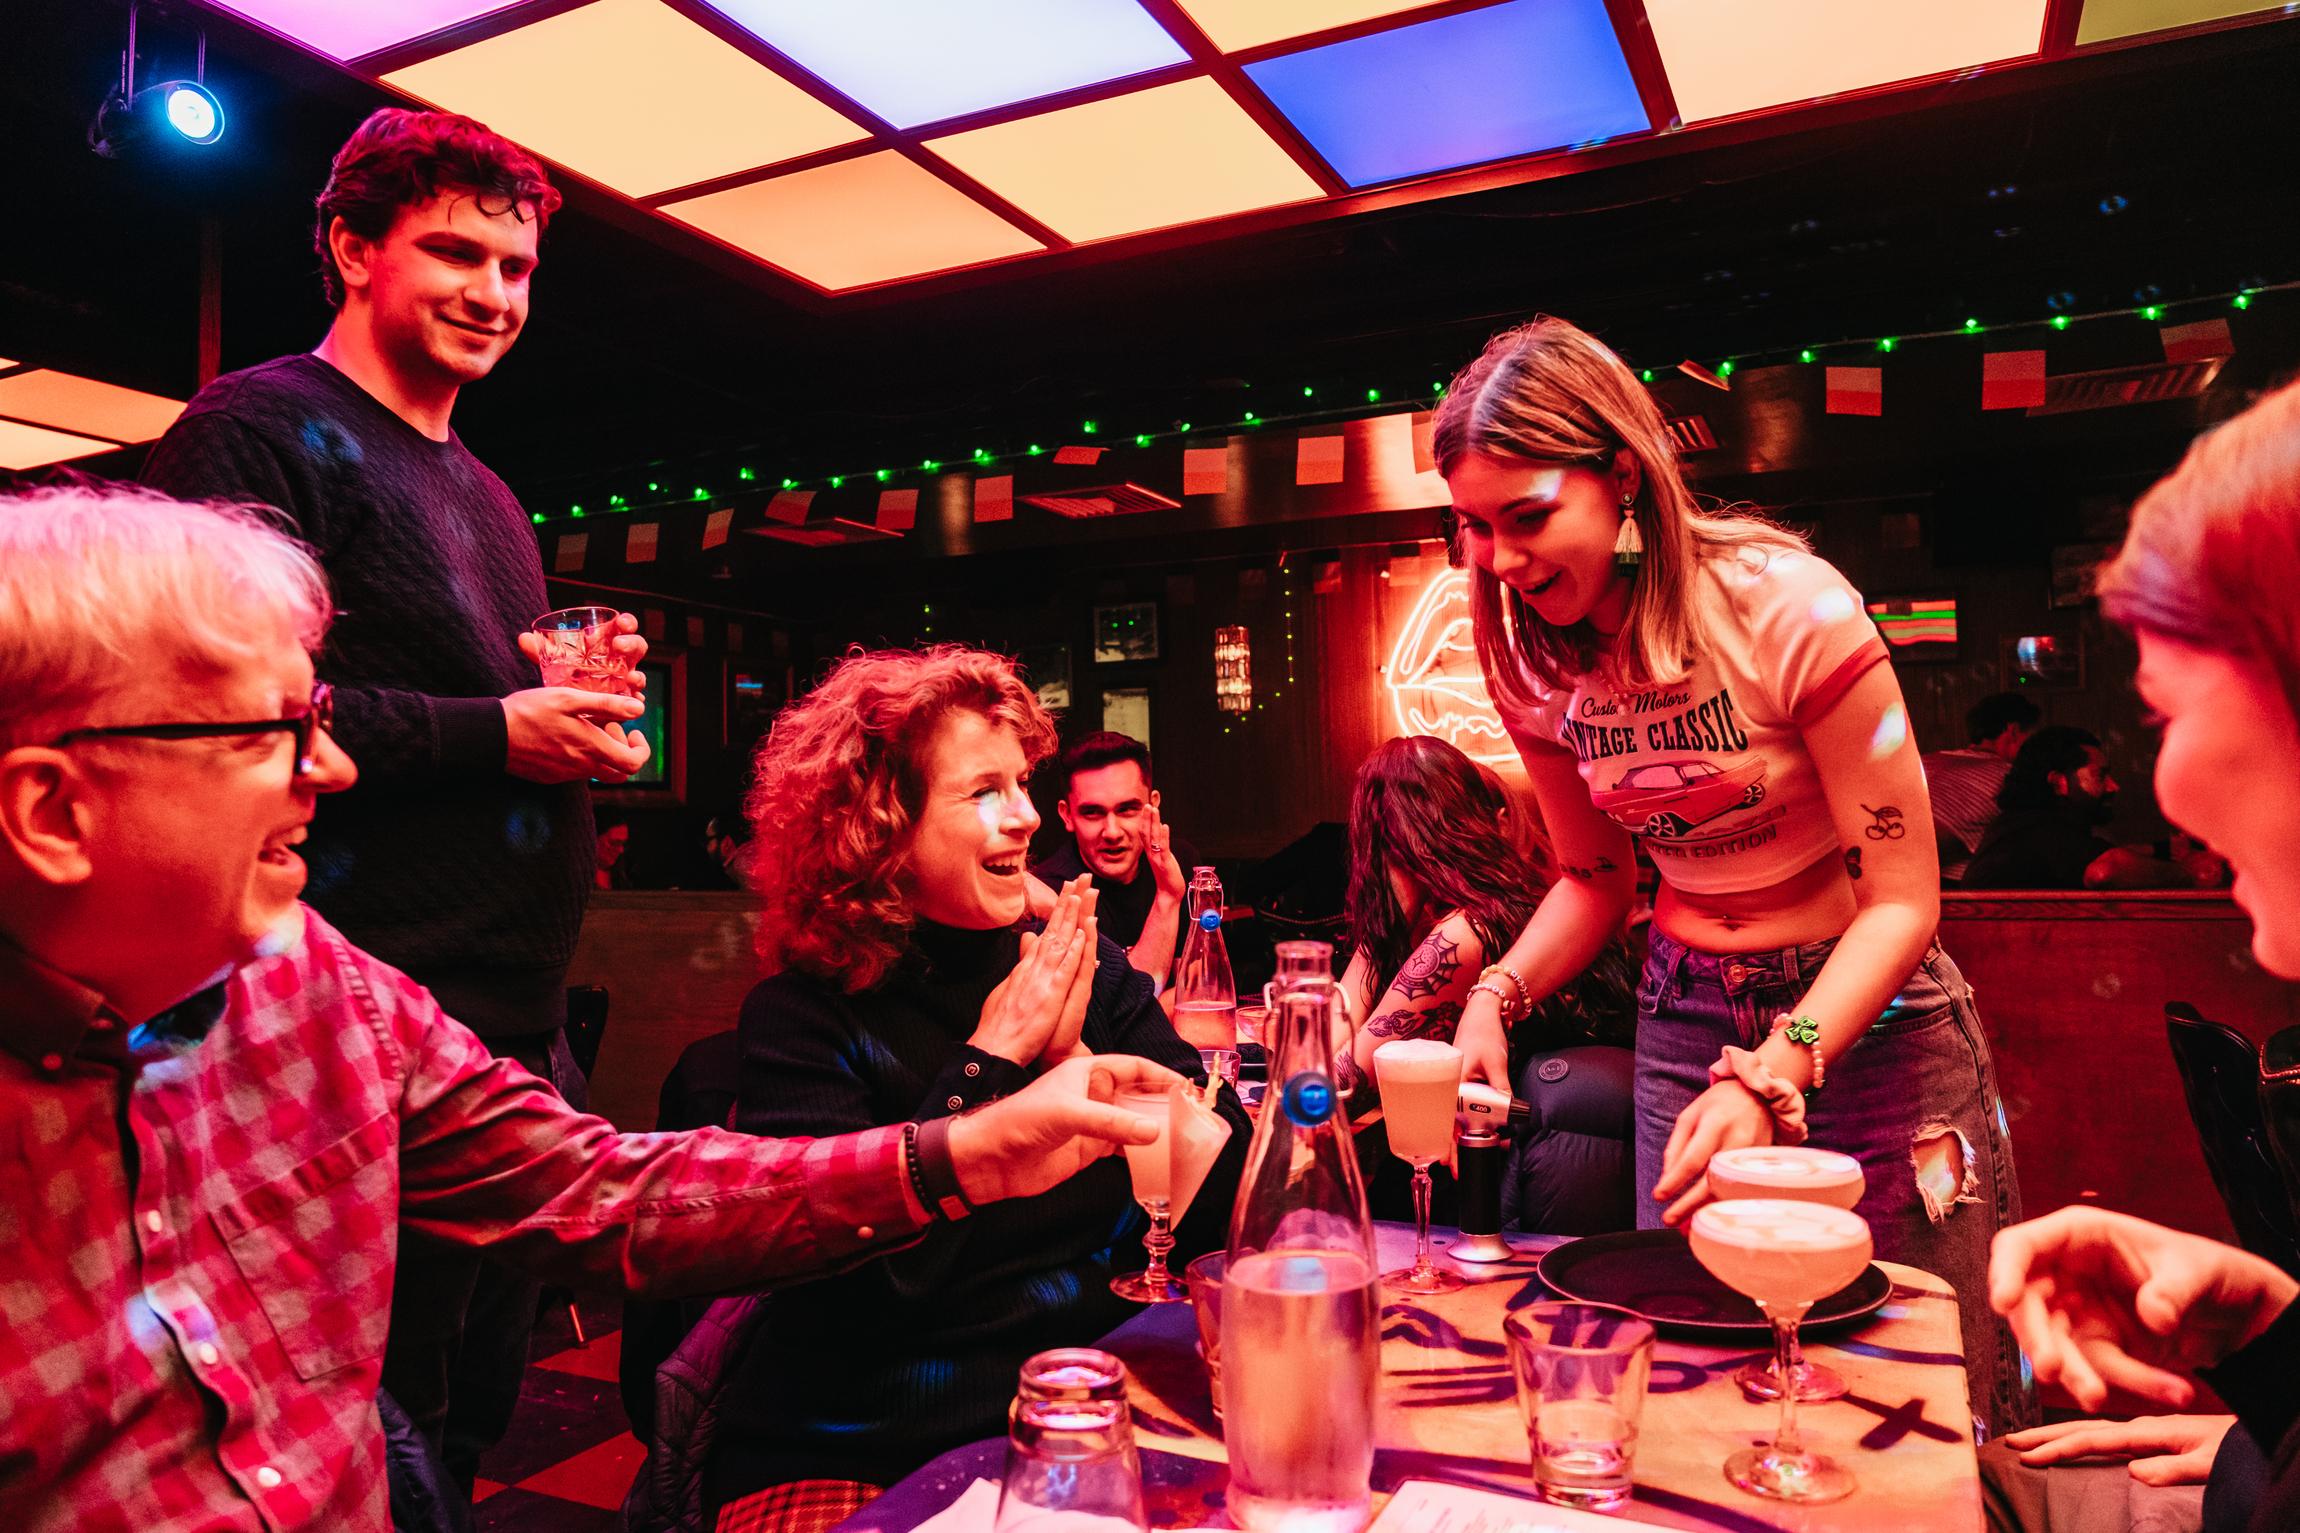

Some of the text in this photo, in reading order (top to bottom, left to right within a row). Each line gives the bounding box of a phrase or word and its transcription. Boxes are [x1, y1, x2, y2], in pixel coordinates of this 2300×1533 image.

[1562, 688, 1749, 763] NTAGE CLASSIC
[1581, 691, 1691, 718] Custo Motors
